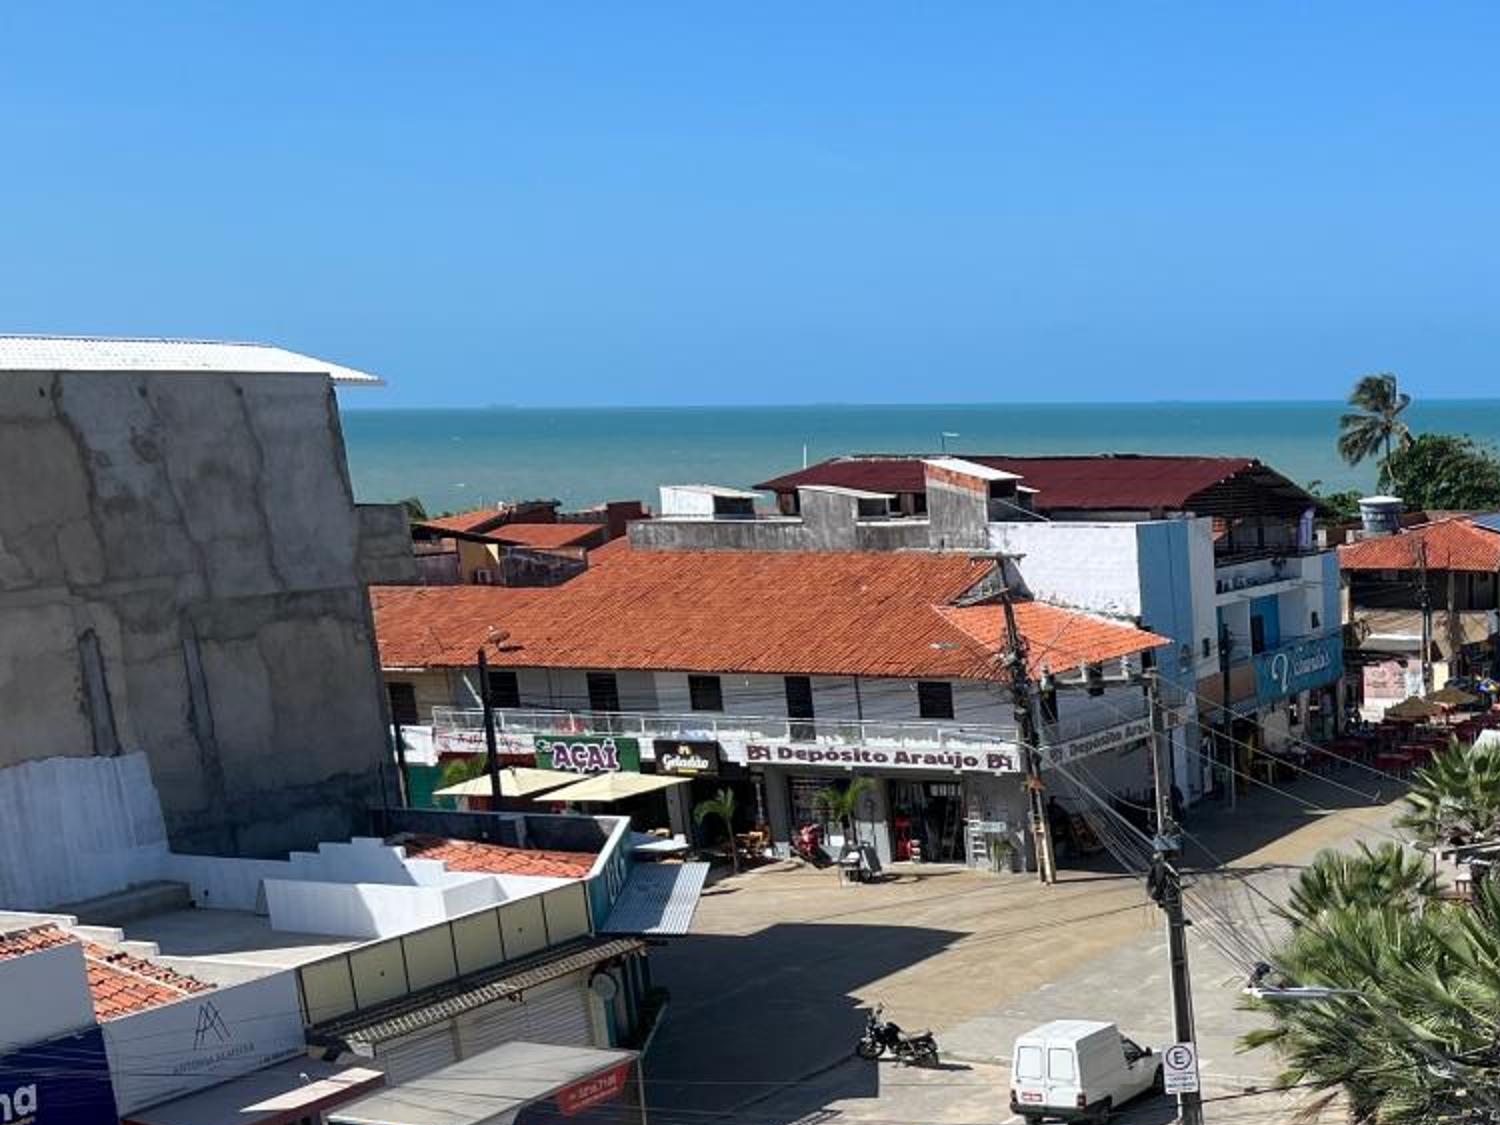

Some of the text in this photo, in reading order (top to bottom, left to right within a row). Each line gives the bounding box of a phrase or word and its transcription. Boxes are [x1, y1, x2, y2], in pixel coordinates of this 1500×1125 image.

[552, 738, 619, 773] AÇAÍ
[777, 746, 888, 767] Depósito
[894, 750, 978, 769] Araújo
[1174, 1051, 1185, 1065] E
